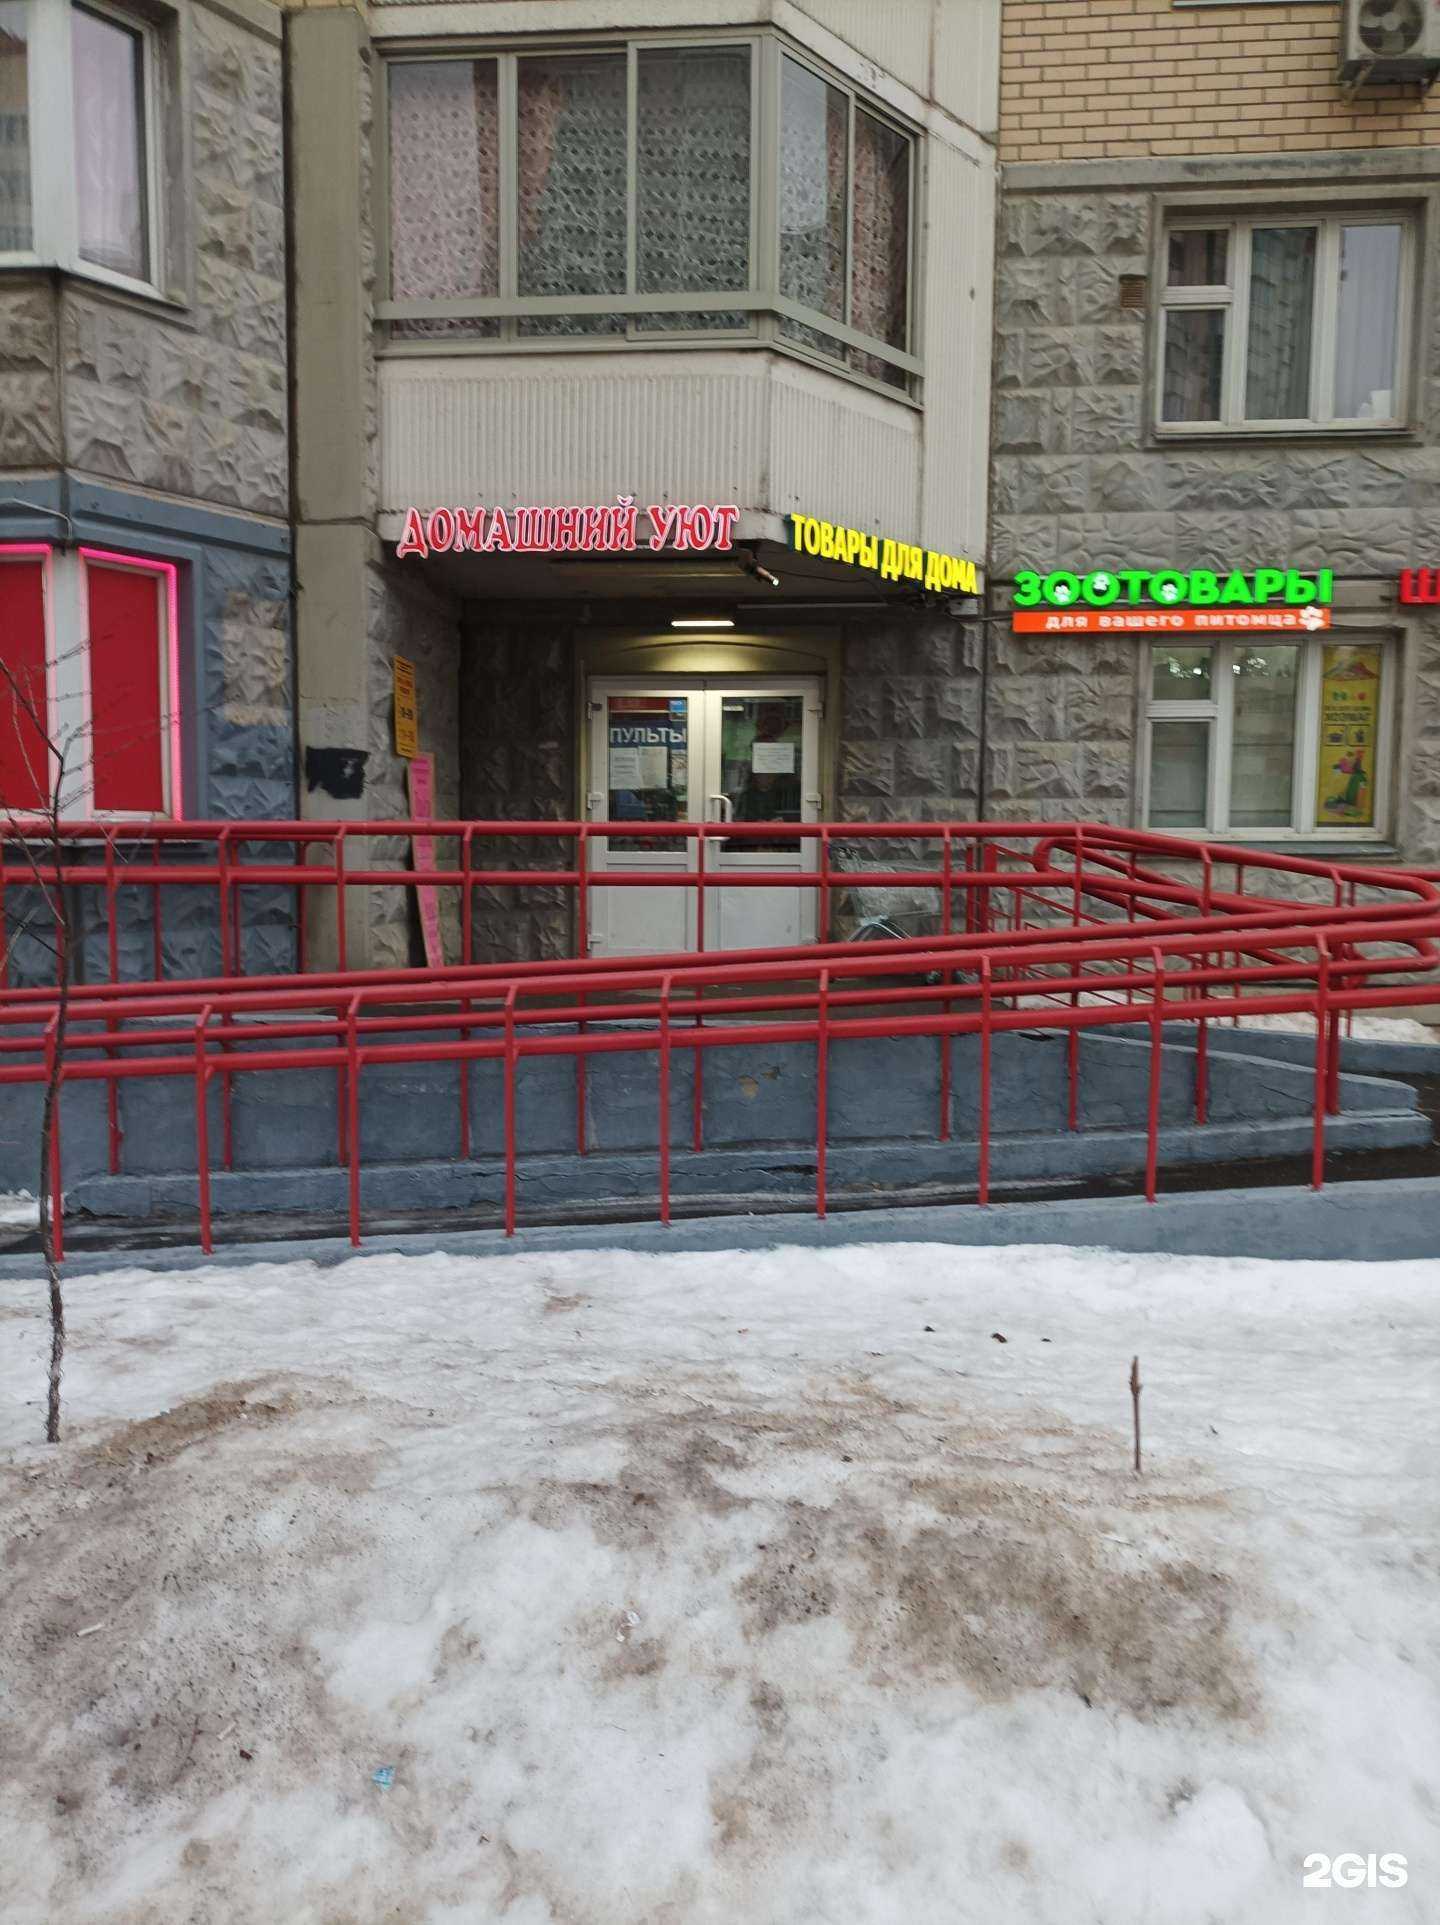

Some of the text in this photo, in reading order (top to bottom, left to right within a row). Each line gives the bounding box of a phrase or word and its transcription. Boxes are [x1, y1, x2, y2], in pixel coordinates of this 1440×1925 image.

[396, 495, 740, 559] ДОМАШНИЙ УЮТ
[790, 512, 978, 594] ТОВАРЫ ДЛЯ ДОМА
[1013, 568, 1333, 607] ЗООТОВАРЫ
[1045, 612, 1297, 629] для вашего питомца
[609, 727, 687, 744] ПУЛЬТЫ
